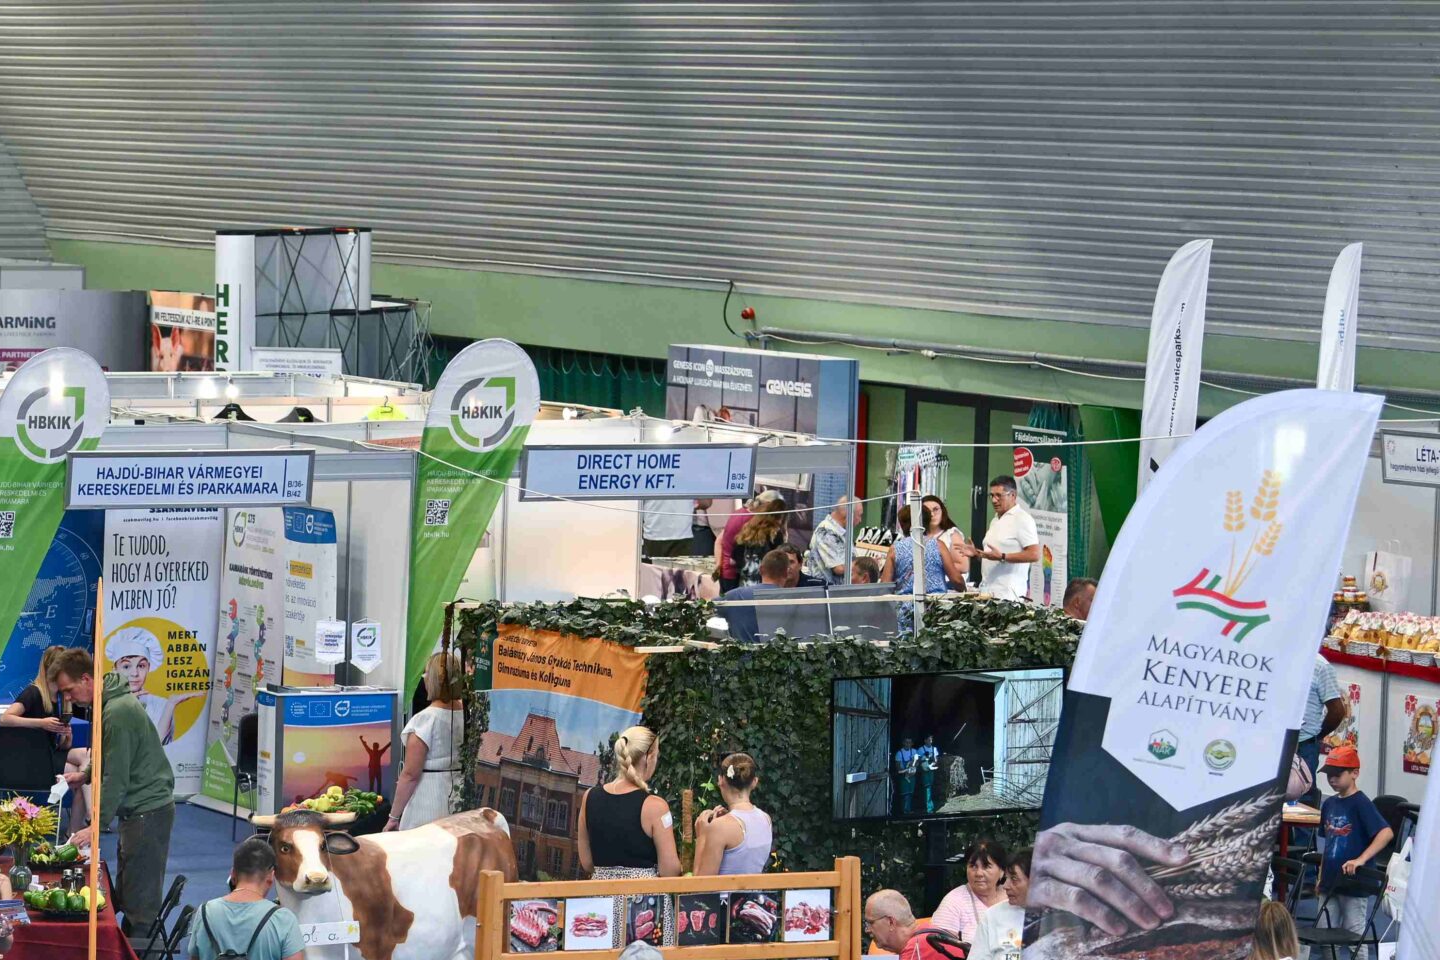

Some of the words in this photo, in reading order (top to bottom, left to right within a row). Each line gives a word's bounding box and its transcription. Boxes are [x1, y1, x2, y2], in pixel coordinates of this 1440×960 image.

[462, 405, 503, 419] HBKIK
[28, 415, 72, 430] HBKIK
[577, 454, 632, 469] DIRECT
[637, 454, 681, 469] HOME
[97, 463, 183, 480] HAJDÚ-BIHAR
[188, 463, 263, 479] VÁRMEGYEI
[78, 483, 174, 496] KERESKEDELMI
[179, 480, 193, 495] ÉS
[197, 482, 278, 495] IPARKAMARA
[578, 474, 640, 489] ENERGY
[645, 474, 676, 489] KFT.
[128, 534, 170, 557] TUDOD,
[111, 562, 141, 583] HOGY
[144, 561, 151, 582] A
[155, 561, 209, 582] GYEREKED
[111, 589, 153, 611] MIBEN
[155, 583, 177, 612] JÓ?
[45, 604, 58, 619] E
[168, 630, 199, 640] MERT
[167, 643, 207, 653] ABBAN
[1147, 633, 1274, 673] MAGYAROK
[167, 656, 193, 666] LESZ
[166, 666, 210, 679] IGAZÁN
[1142, 658, 1269, 702] KENYERE
[165, 681, 214, 691] SIKERES!
[1137, 690, 1263, 724] ALAPÍTVÁNY
